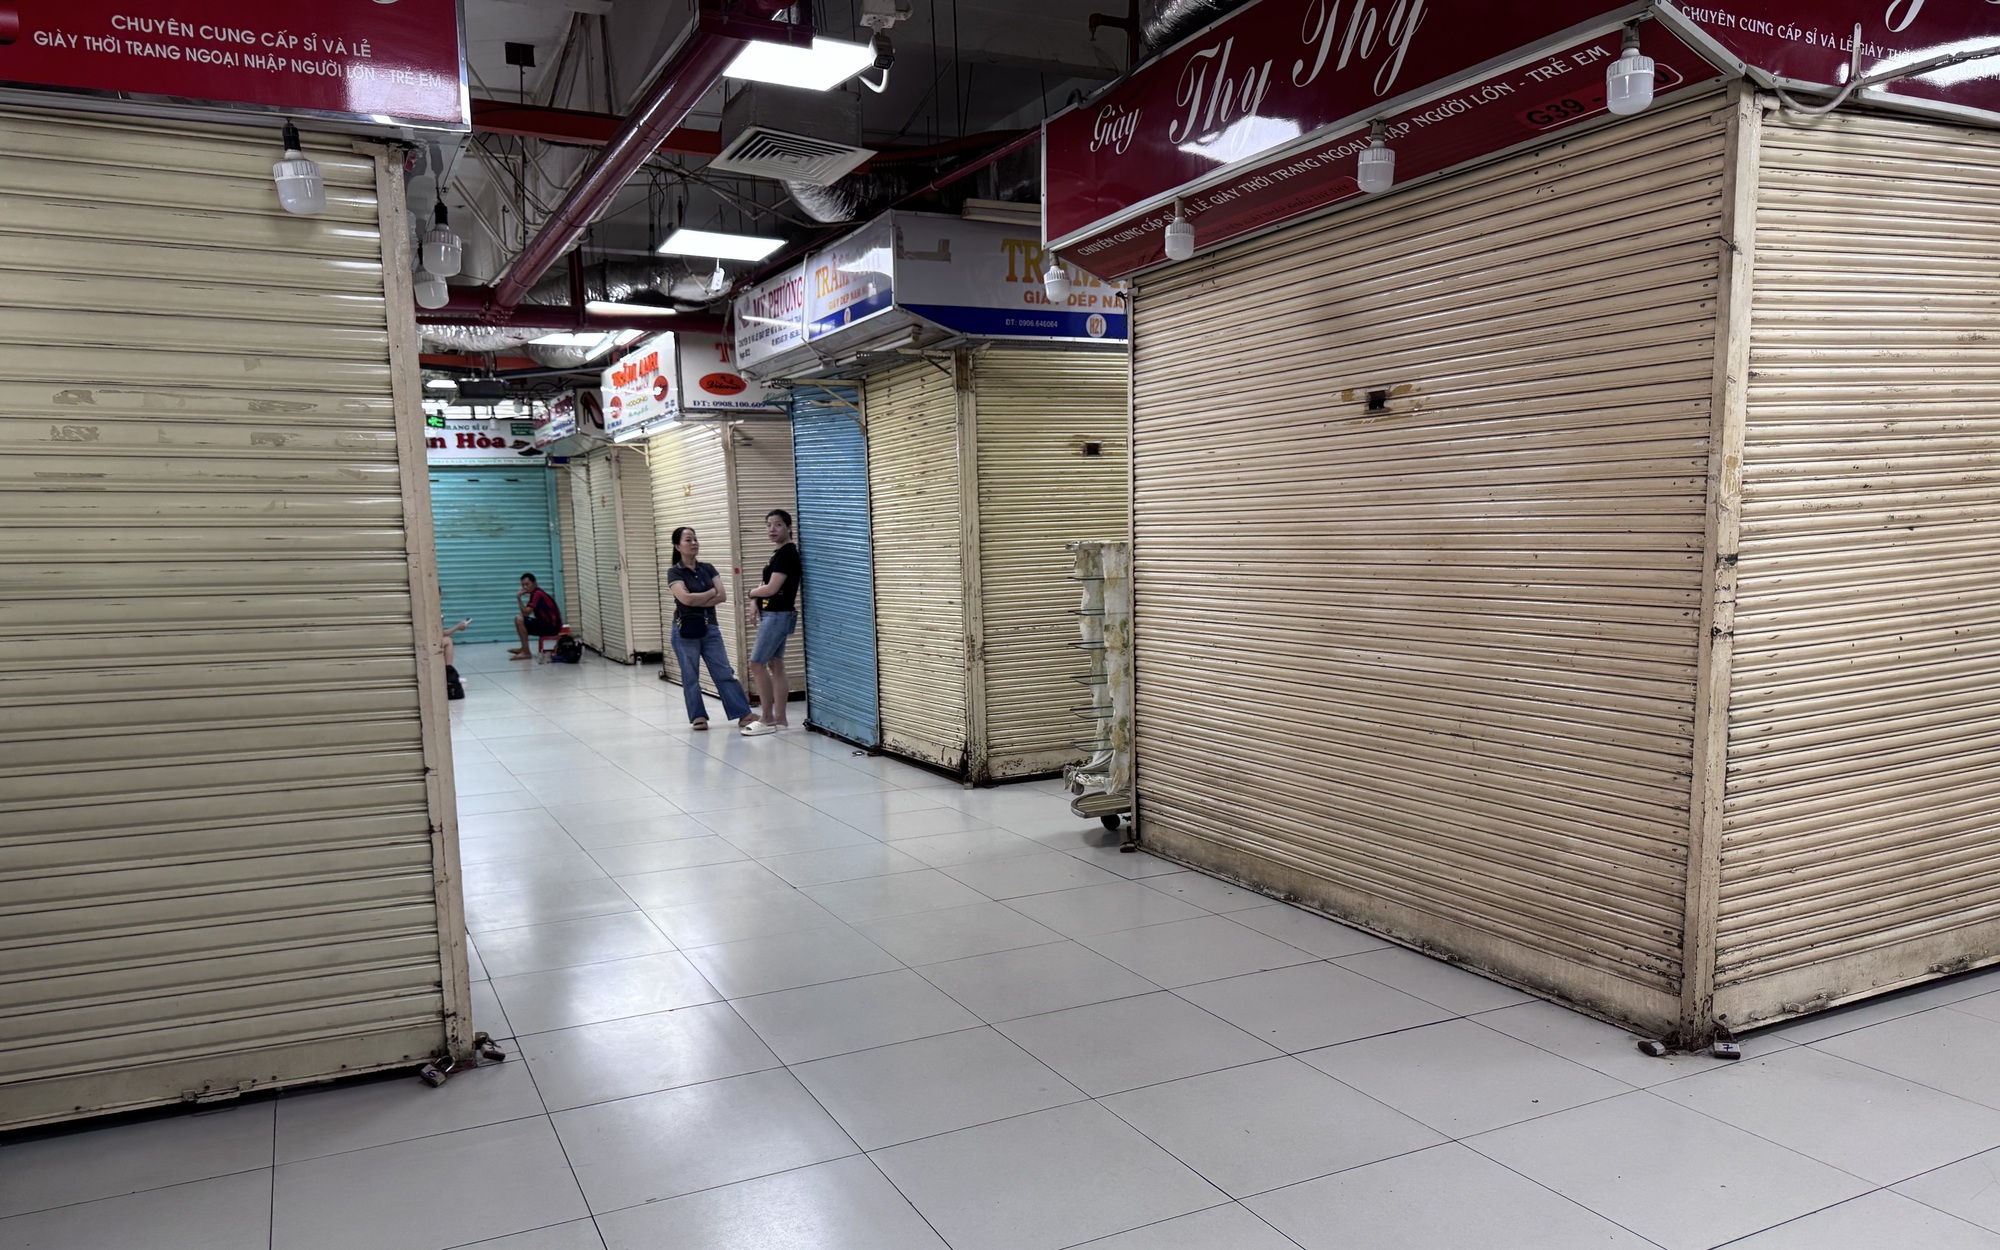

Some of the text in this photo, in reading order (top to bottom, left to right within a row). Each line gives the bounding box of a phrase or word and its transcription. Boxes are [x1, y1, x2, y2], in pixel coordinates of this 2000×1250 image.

[111, 14, 372, 58] CHUYÊN CUNG CẤP SỈ VÀ LẺ
[1682, 5, 1736, 28] CHUYÊN
[1739, 17, 1774, 36] CUNG
[1777, 22, 1802, 41] CẤP
[1805, 27, 1817, 45] SỈ
[1820, 32, 1836, 49] VÀ
[1840, 34, 1853, 52] LẺ
[33, 28, 78, 49] GIÀY
[84, 34, 121, 54] THỜI
[125, 40, 181, 60] TRANG
[186, 47, 239, 68] NGOẠI
[244, 53, 287, 73] NHẬP
[291, 58, 342, 77] NGƯỜI
[347, 62, 375, 81] LỚN
[390, 66, 414, 85] TRẺ
[420, 73, 442, 88] EM
[1090, 104, 1143, 155] Giày
[1168, 35, 1273, 154] Thy
[1526, 98, 1585, 125] G39
[1077, 238, 1116, 257] CHUYÊN
[1113, 226, 1145, 243] CUNG
[1141, 217, 1164, 232] CẤP
[1192, 197, 1213, 212] LẺ
[1209, 190, 1241, 205] GIÀY
[1238, 175, 1275, 193] THỜI
[1269, 158, 1321, 181] TRANG
[1411, 98, 1473, 128] NGƯỜI
[1469, 82, 1516, 105] LỚN
[1525, 57, 1573, 83] TRẺ
[1570, 45, 1612, 66] EM
[1067, 291, 1098, 307] DÉP
[456, 432, 506, 449] Hòa
